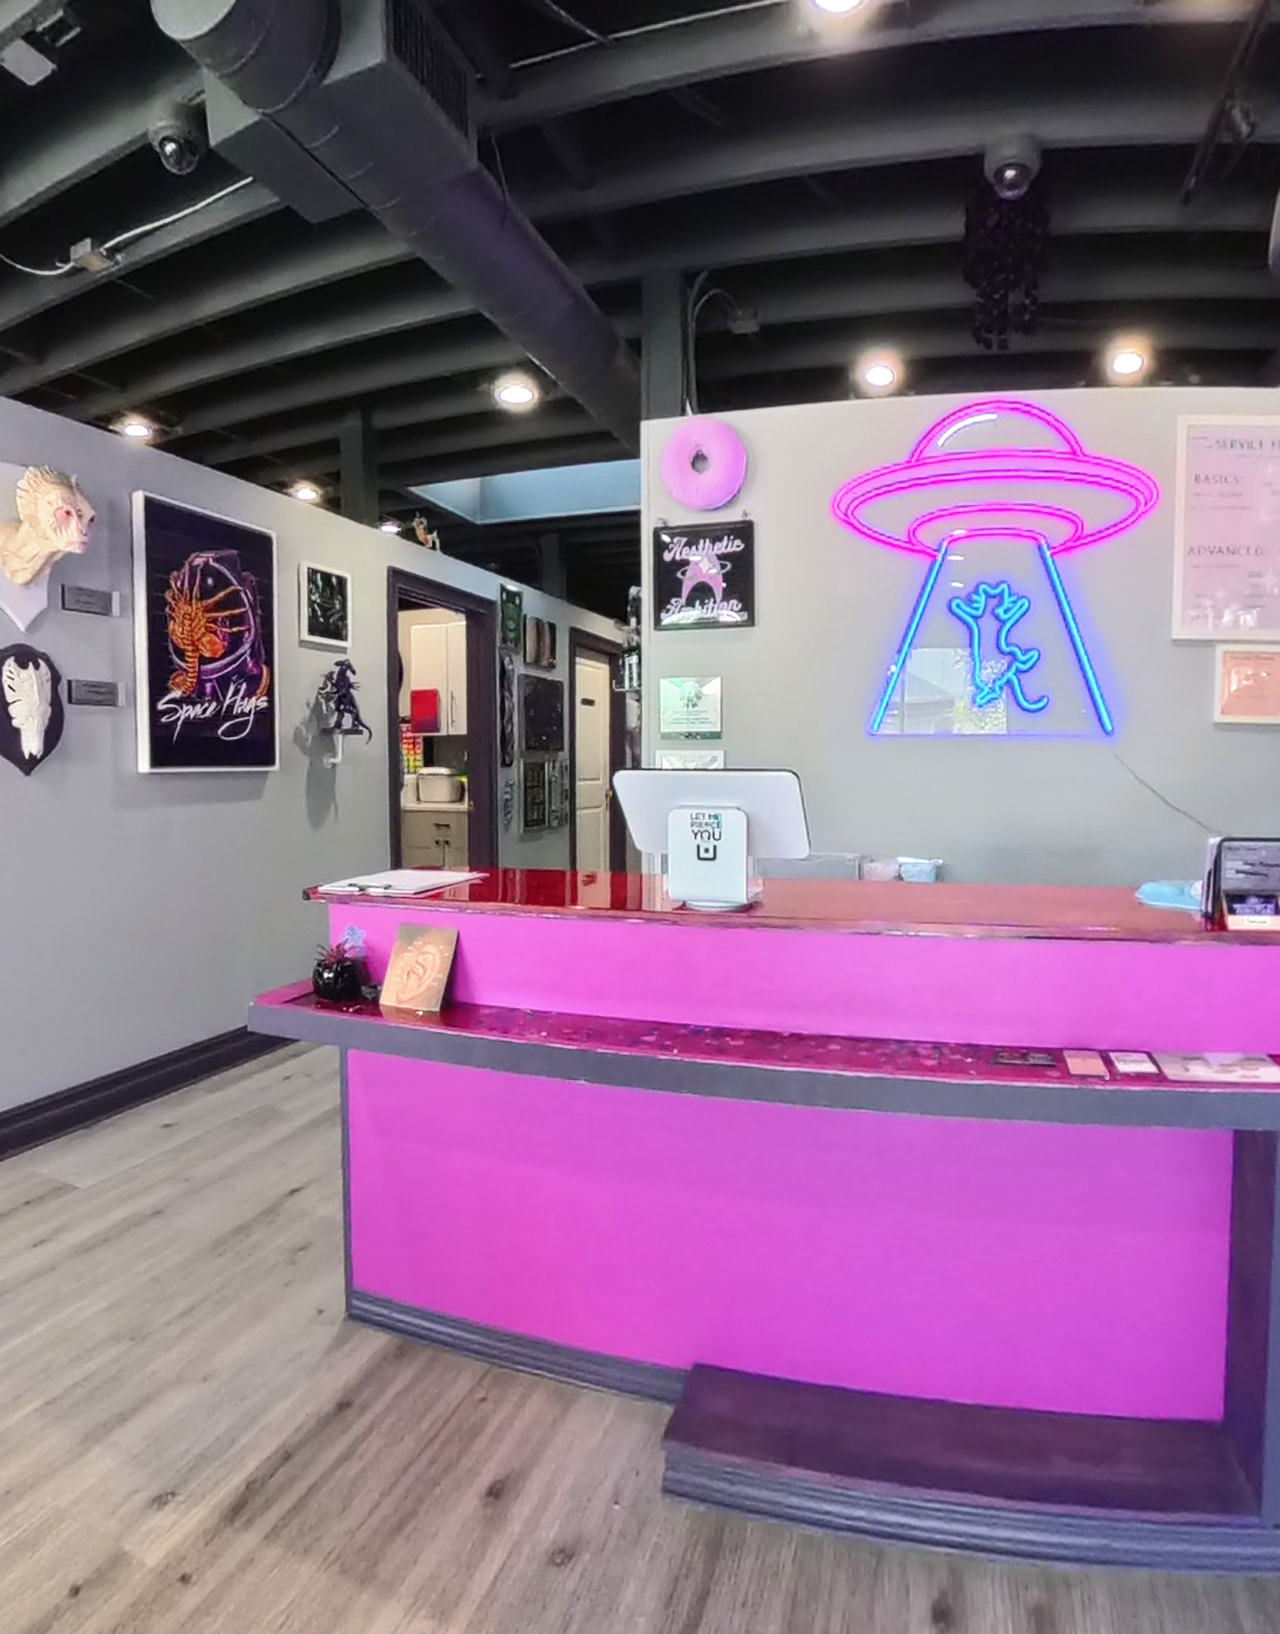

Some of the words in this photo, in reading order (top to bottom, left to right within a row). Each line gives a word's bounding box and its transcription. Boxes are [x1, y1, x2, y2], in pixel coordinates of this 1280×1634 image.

[1194, 473, 1240, 484] BASICS
[663, 535, 745, 562] Aesthetic
[1187, 545, 1263, 556] ADVANCED
[157, 690, 220, 745] Space
[218, 674, 269, 740] Hugs
[691, 828, 722, 842] YOU
